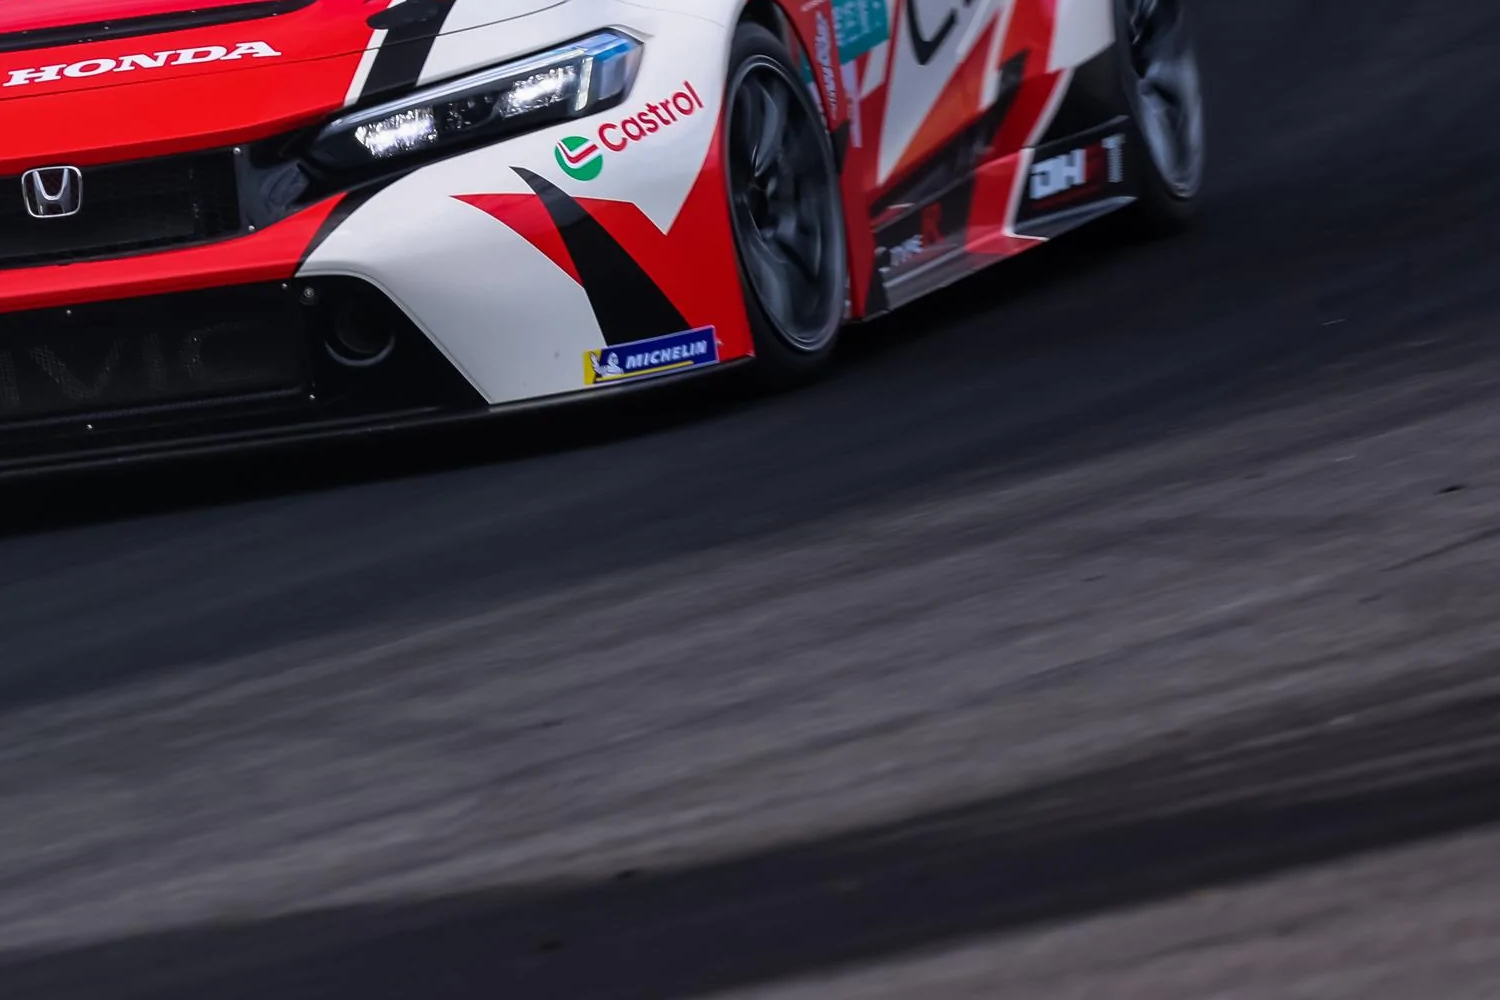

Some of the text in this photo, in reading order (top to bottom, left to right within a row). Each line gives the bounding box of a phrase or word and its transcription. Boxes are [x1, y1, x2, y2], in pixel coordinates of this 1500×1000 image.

[2, 40, 282, 88] HONDA
[597, 80, 705, 153] Castrol
[624, 339, 708, 370] MICHELIN
